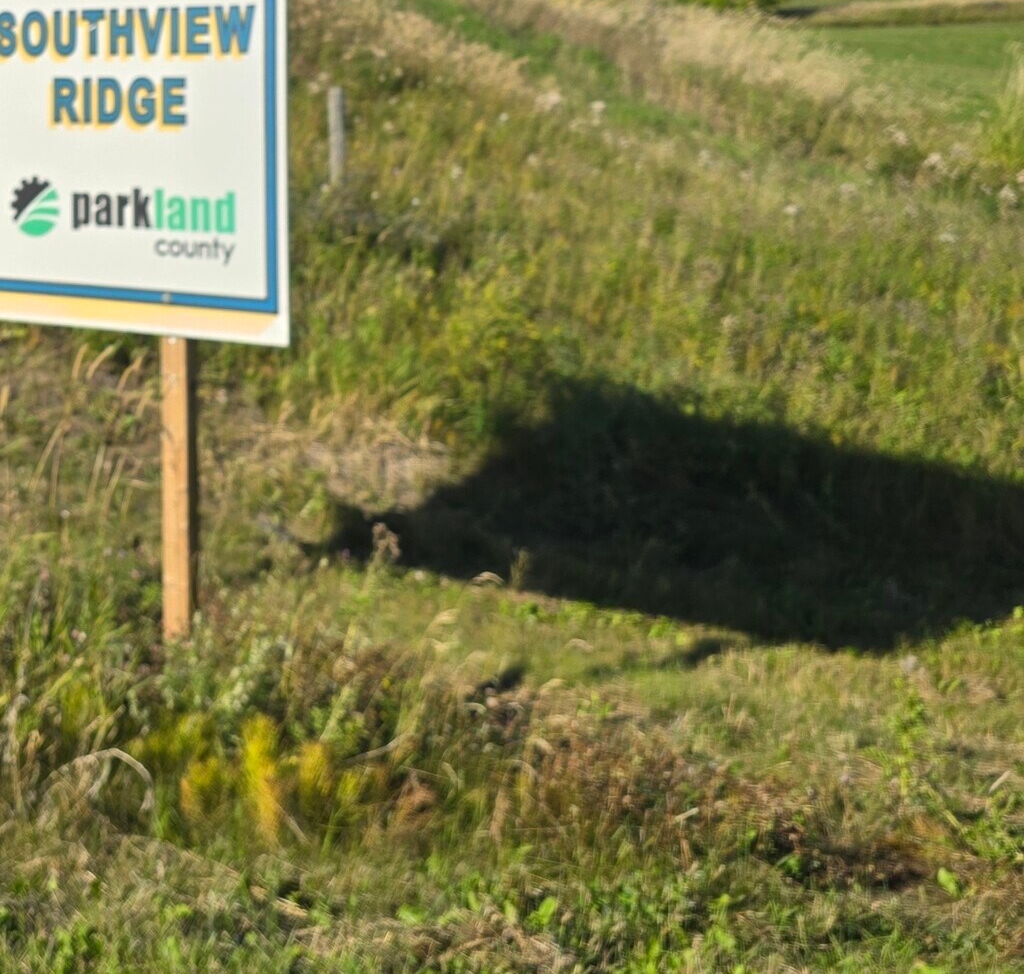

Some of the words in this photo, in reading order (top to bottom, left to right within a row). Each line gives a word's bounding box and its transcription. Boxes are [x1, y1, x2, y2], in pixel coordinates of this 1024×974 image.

[51, 77, 187, 127] RIDGE
[72, 187, 236, 234] parkland
[154, 238, 236, 266] county
